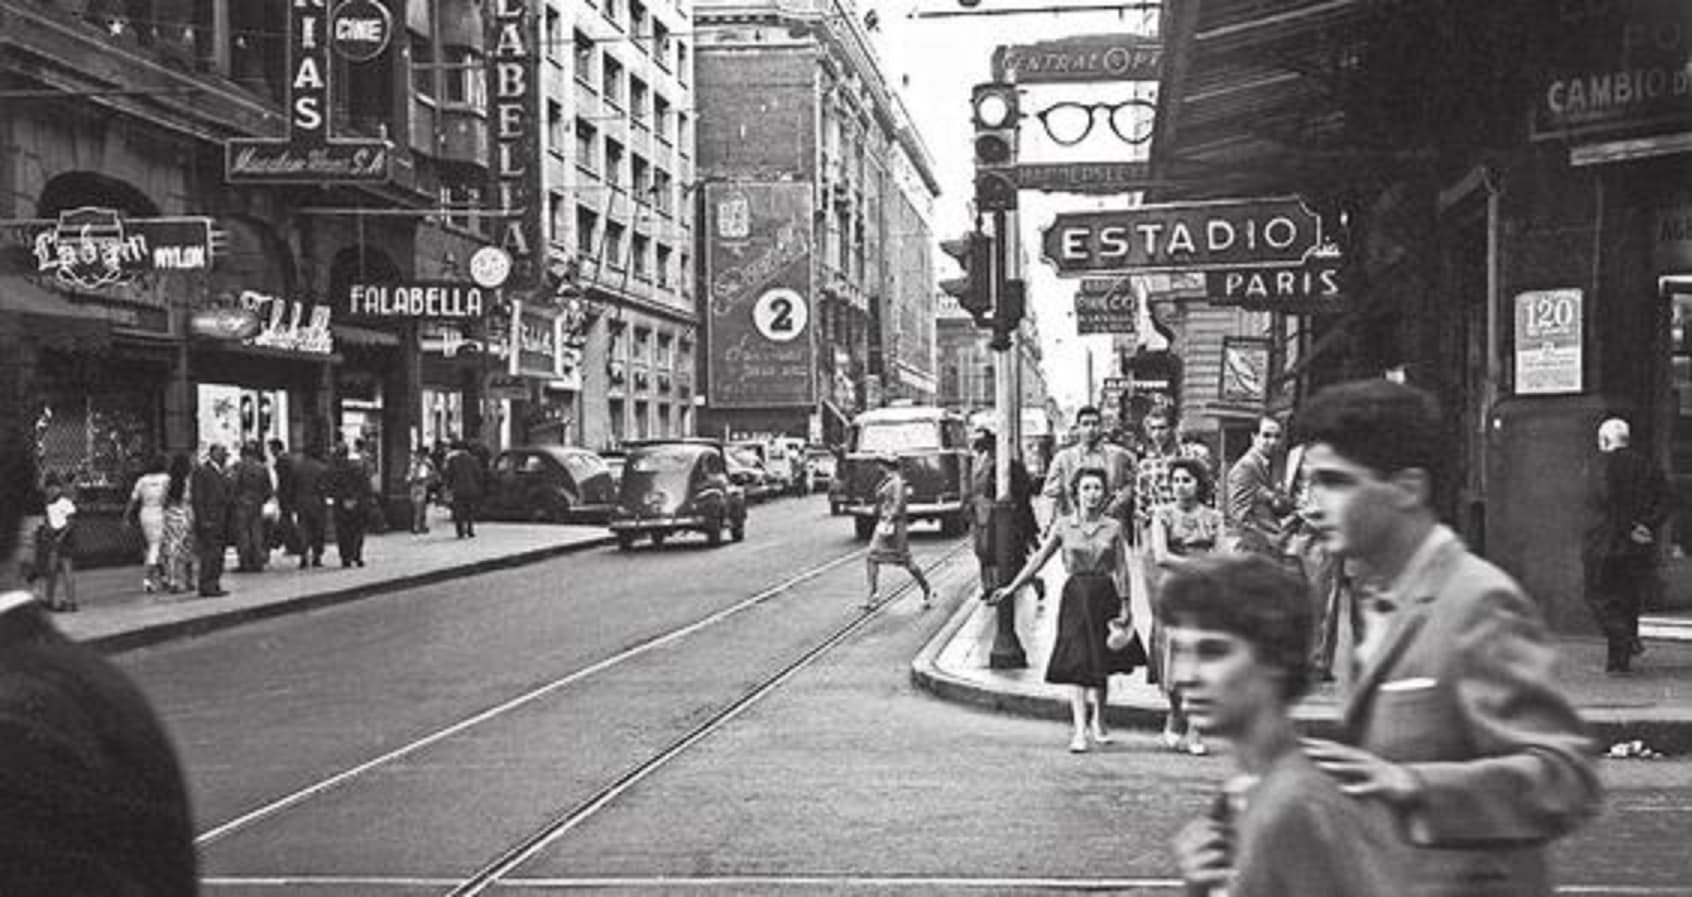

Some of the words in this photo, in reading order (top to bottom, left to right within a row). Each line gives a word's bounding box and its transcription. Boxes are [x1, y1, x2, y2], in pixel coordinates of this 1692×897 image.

[335, 17, 382, 42] CINE
[293, 0, 325, 130] IAS
[1546, 69, 1666, 113] CAMBIO
[1061, 217, 1297, 259] ESTADIO
[1225, 269, 1339, 297] PARIS
[350, 284, 482, 317] FALABELLA
[769, 297, 794, 333] 2
[1524, 299, 1573, 329] 120
